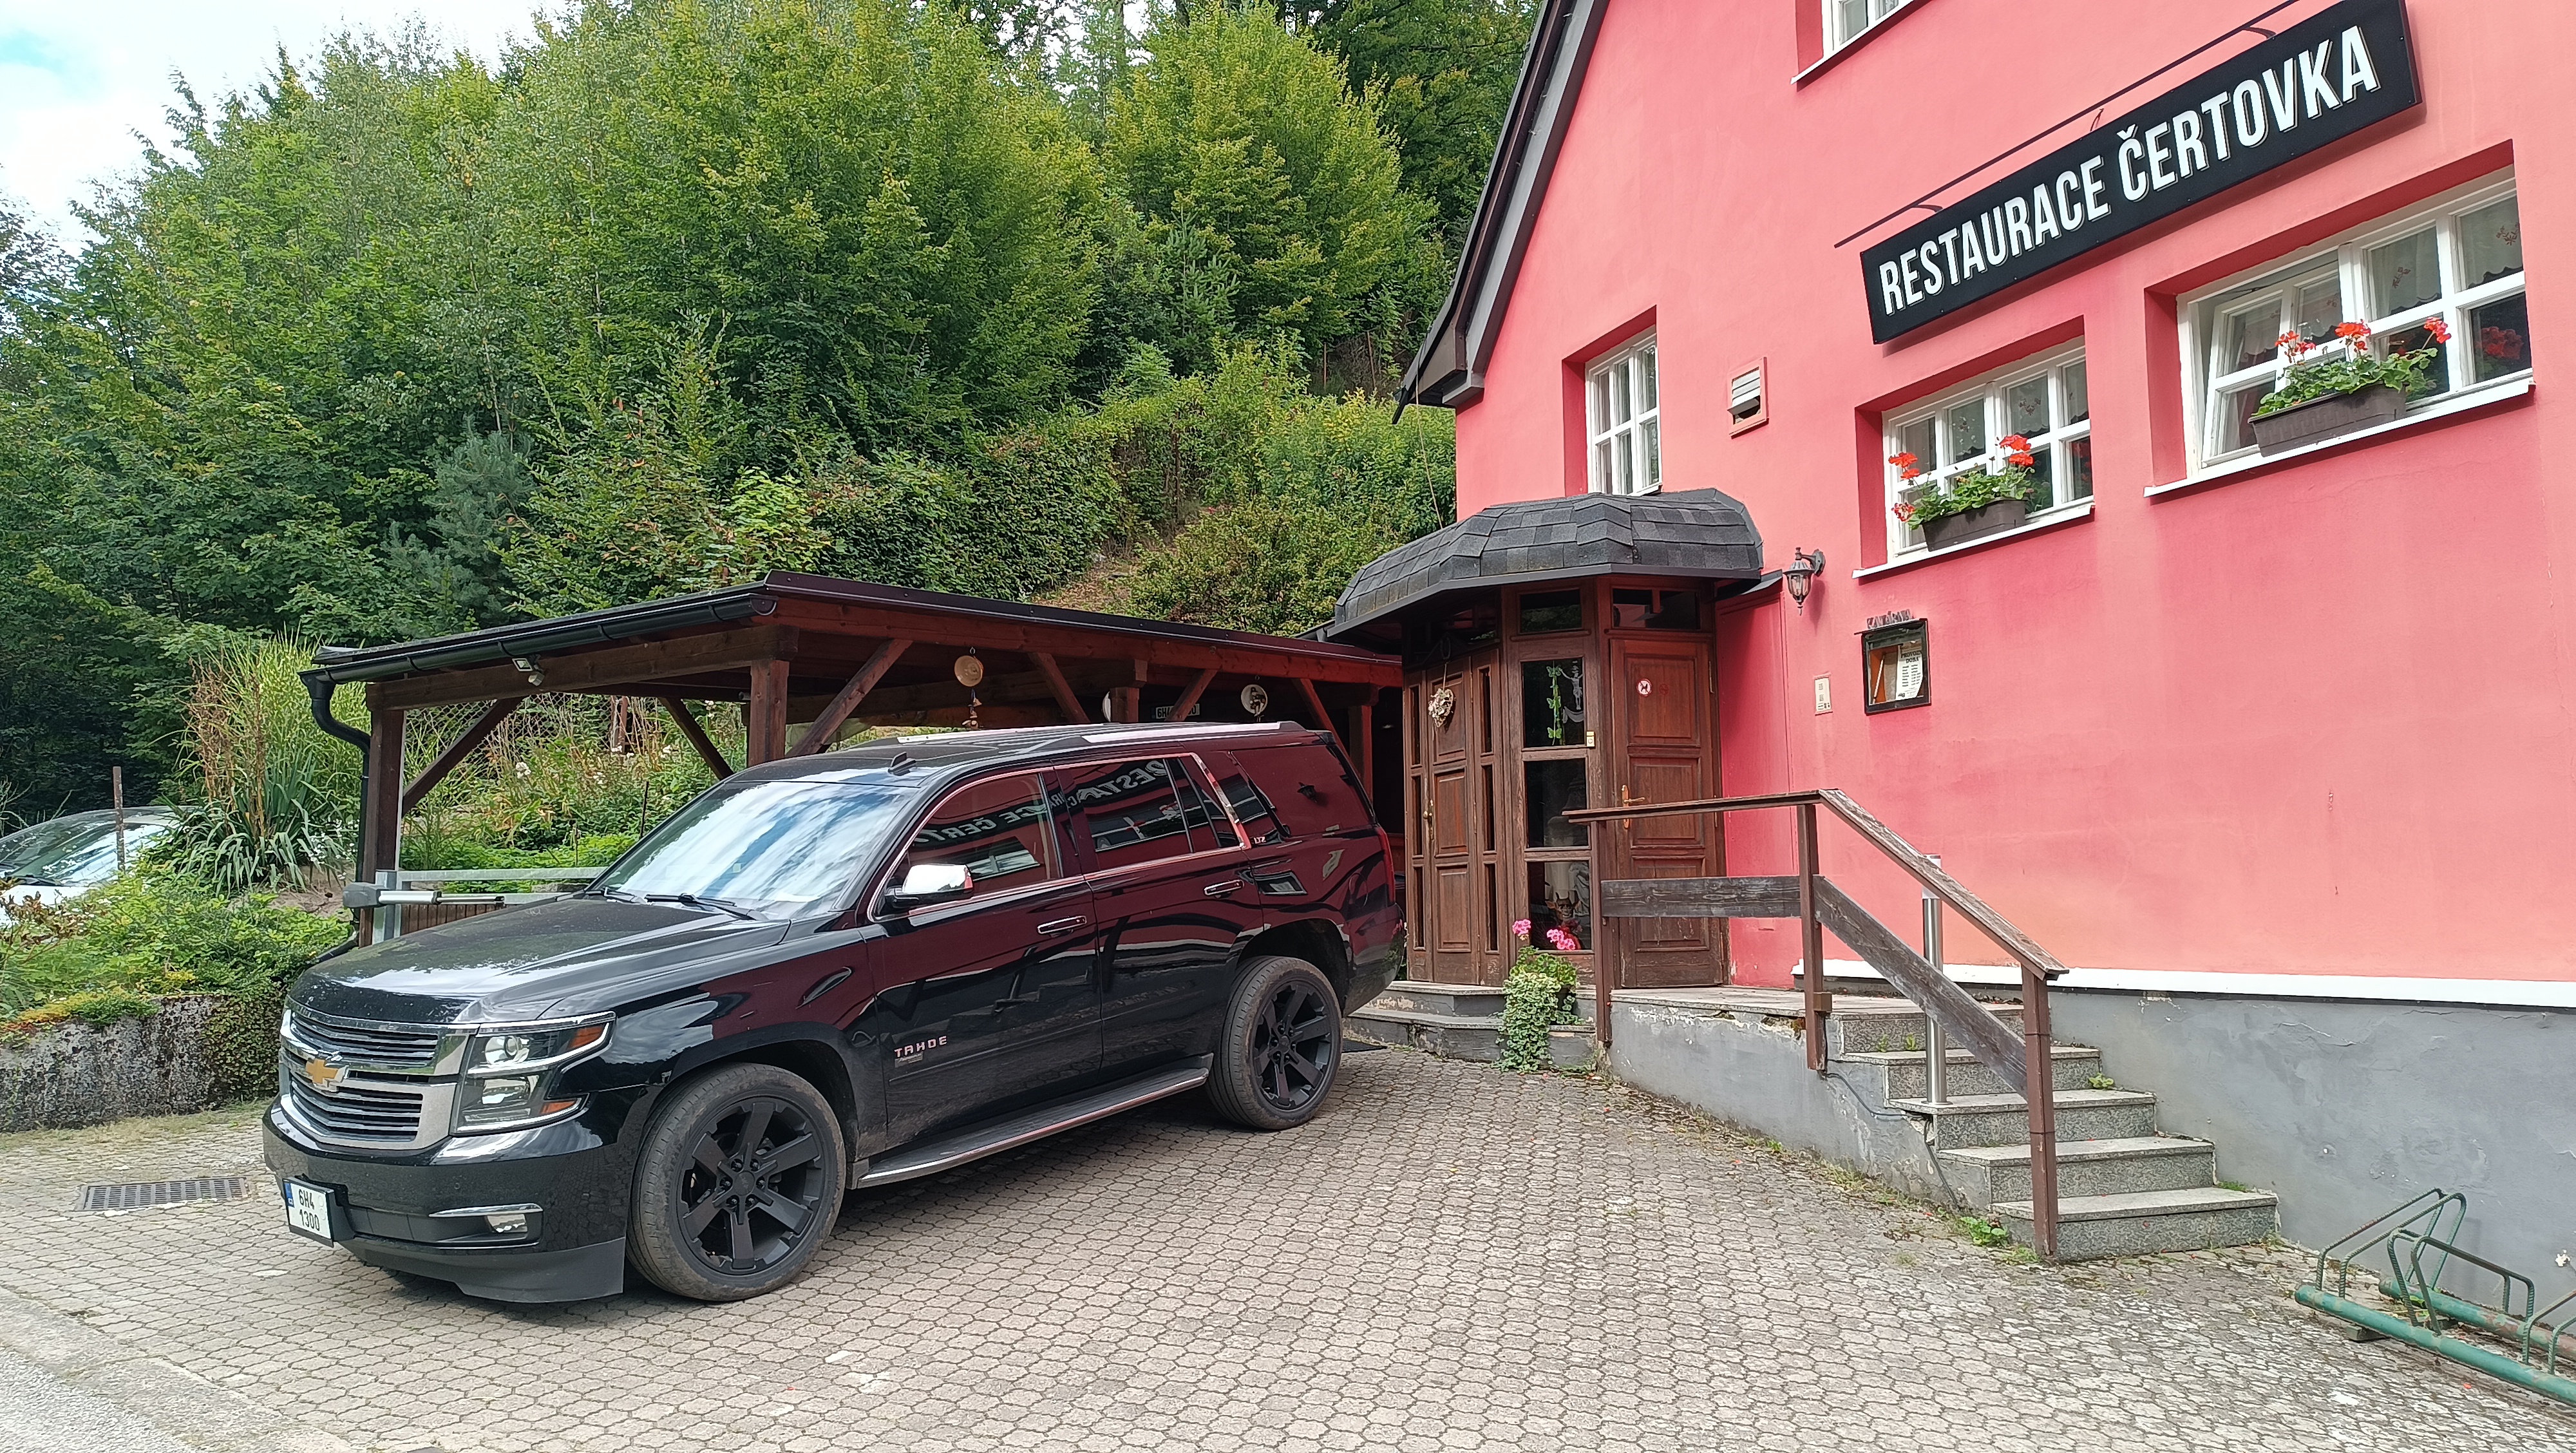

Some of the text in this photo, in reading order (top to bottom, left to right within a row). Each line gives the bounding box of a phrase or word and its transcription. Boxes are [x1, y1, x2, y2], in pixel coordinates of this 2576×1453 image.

[1879, 25, 2382, 317] RESTAURACE ČERTOVKA
[1253, 836, 1267, 844] LTZ
[894, 1036, 947, 1058] TAHOE
[298, 1188, 315, 1210] 6H4
[299, 1209, 321, 1231] 1300
